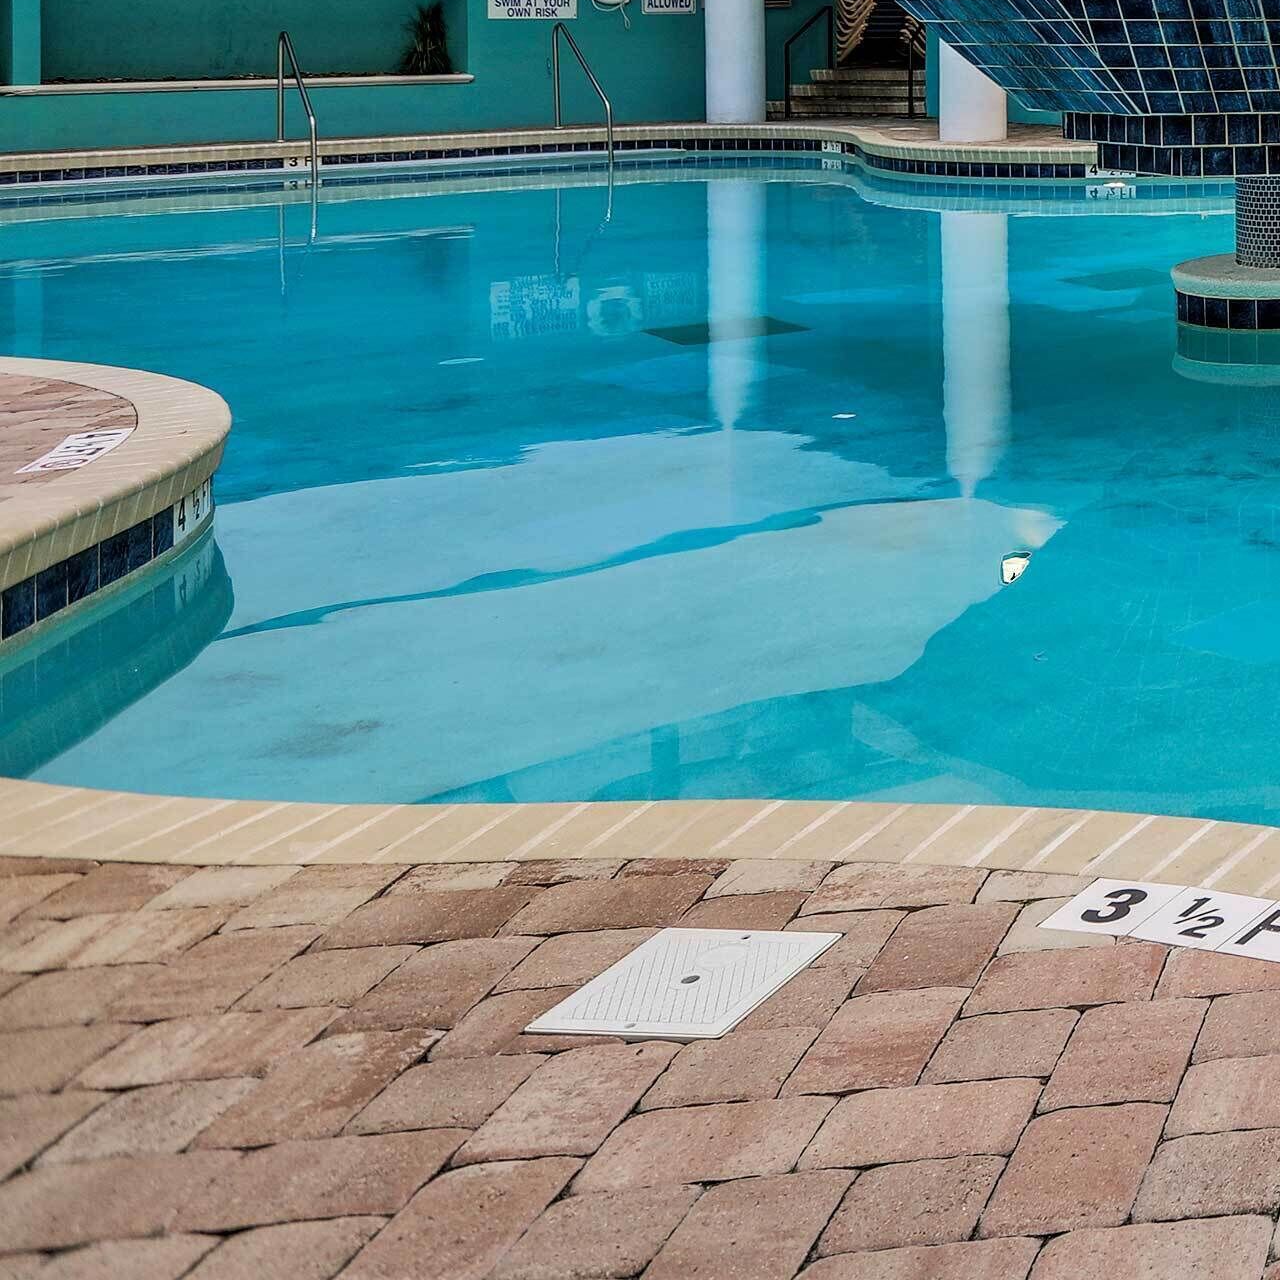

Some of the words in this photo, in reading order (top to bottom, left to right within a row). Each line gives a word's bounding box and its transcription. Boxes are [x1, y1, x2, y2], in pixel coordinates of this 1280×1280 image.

[507, 7, 531, 17] OWN
[535, 7, 558, 17] RISK
[289, 157, 298, 167] 3
[1090, 164, 1098, 175] 4
[178, 496, 186, 531] 4
[1080, 888, 1148, 924] 3
